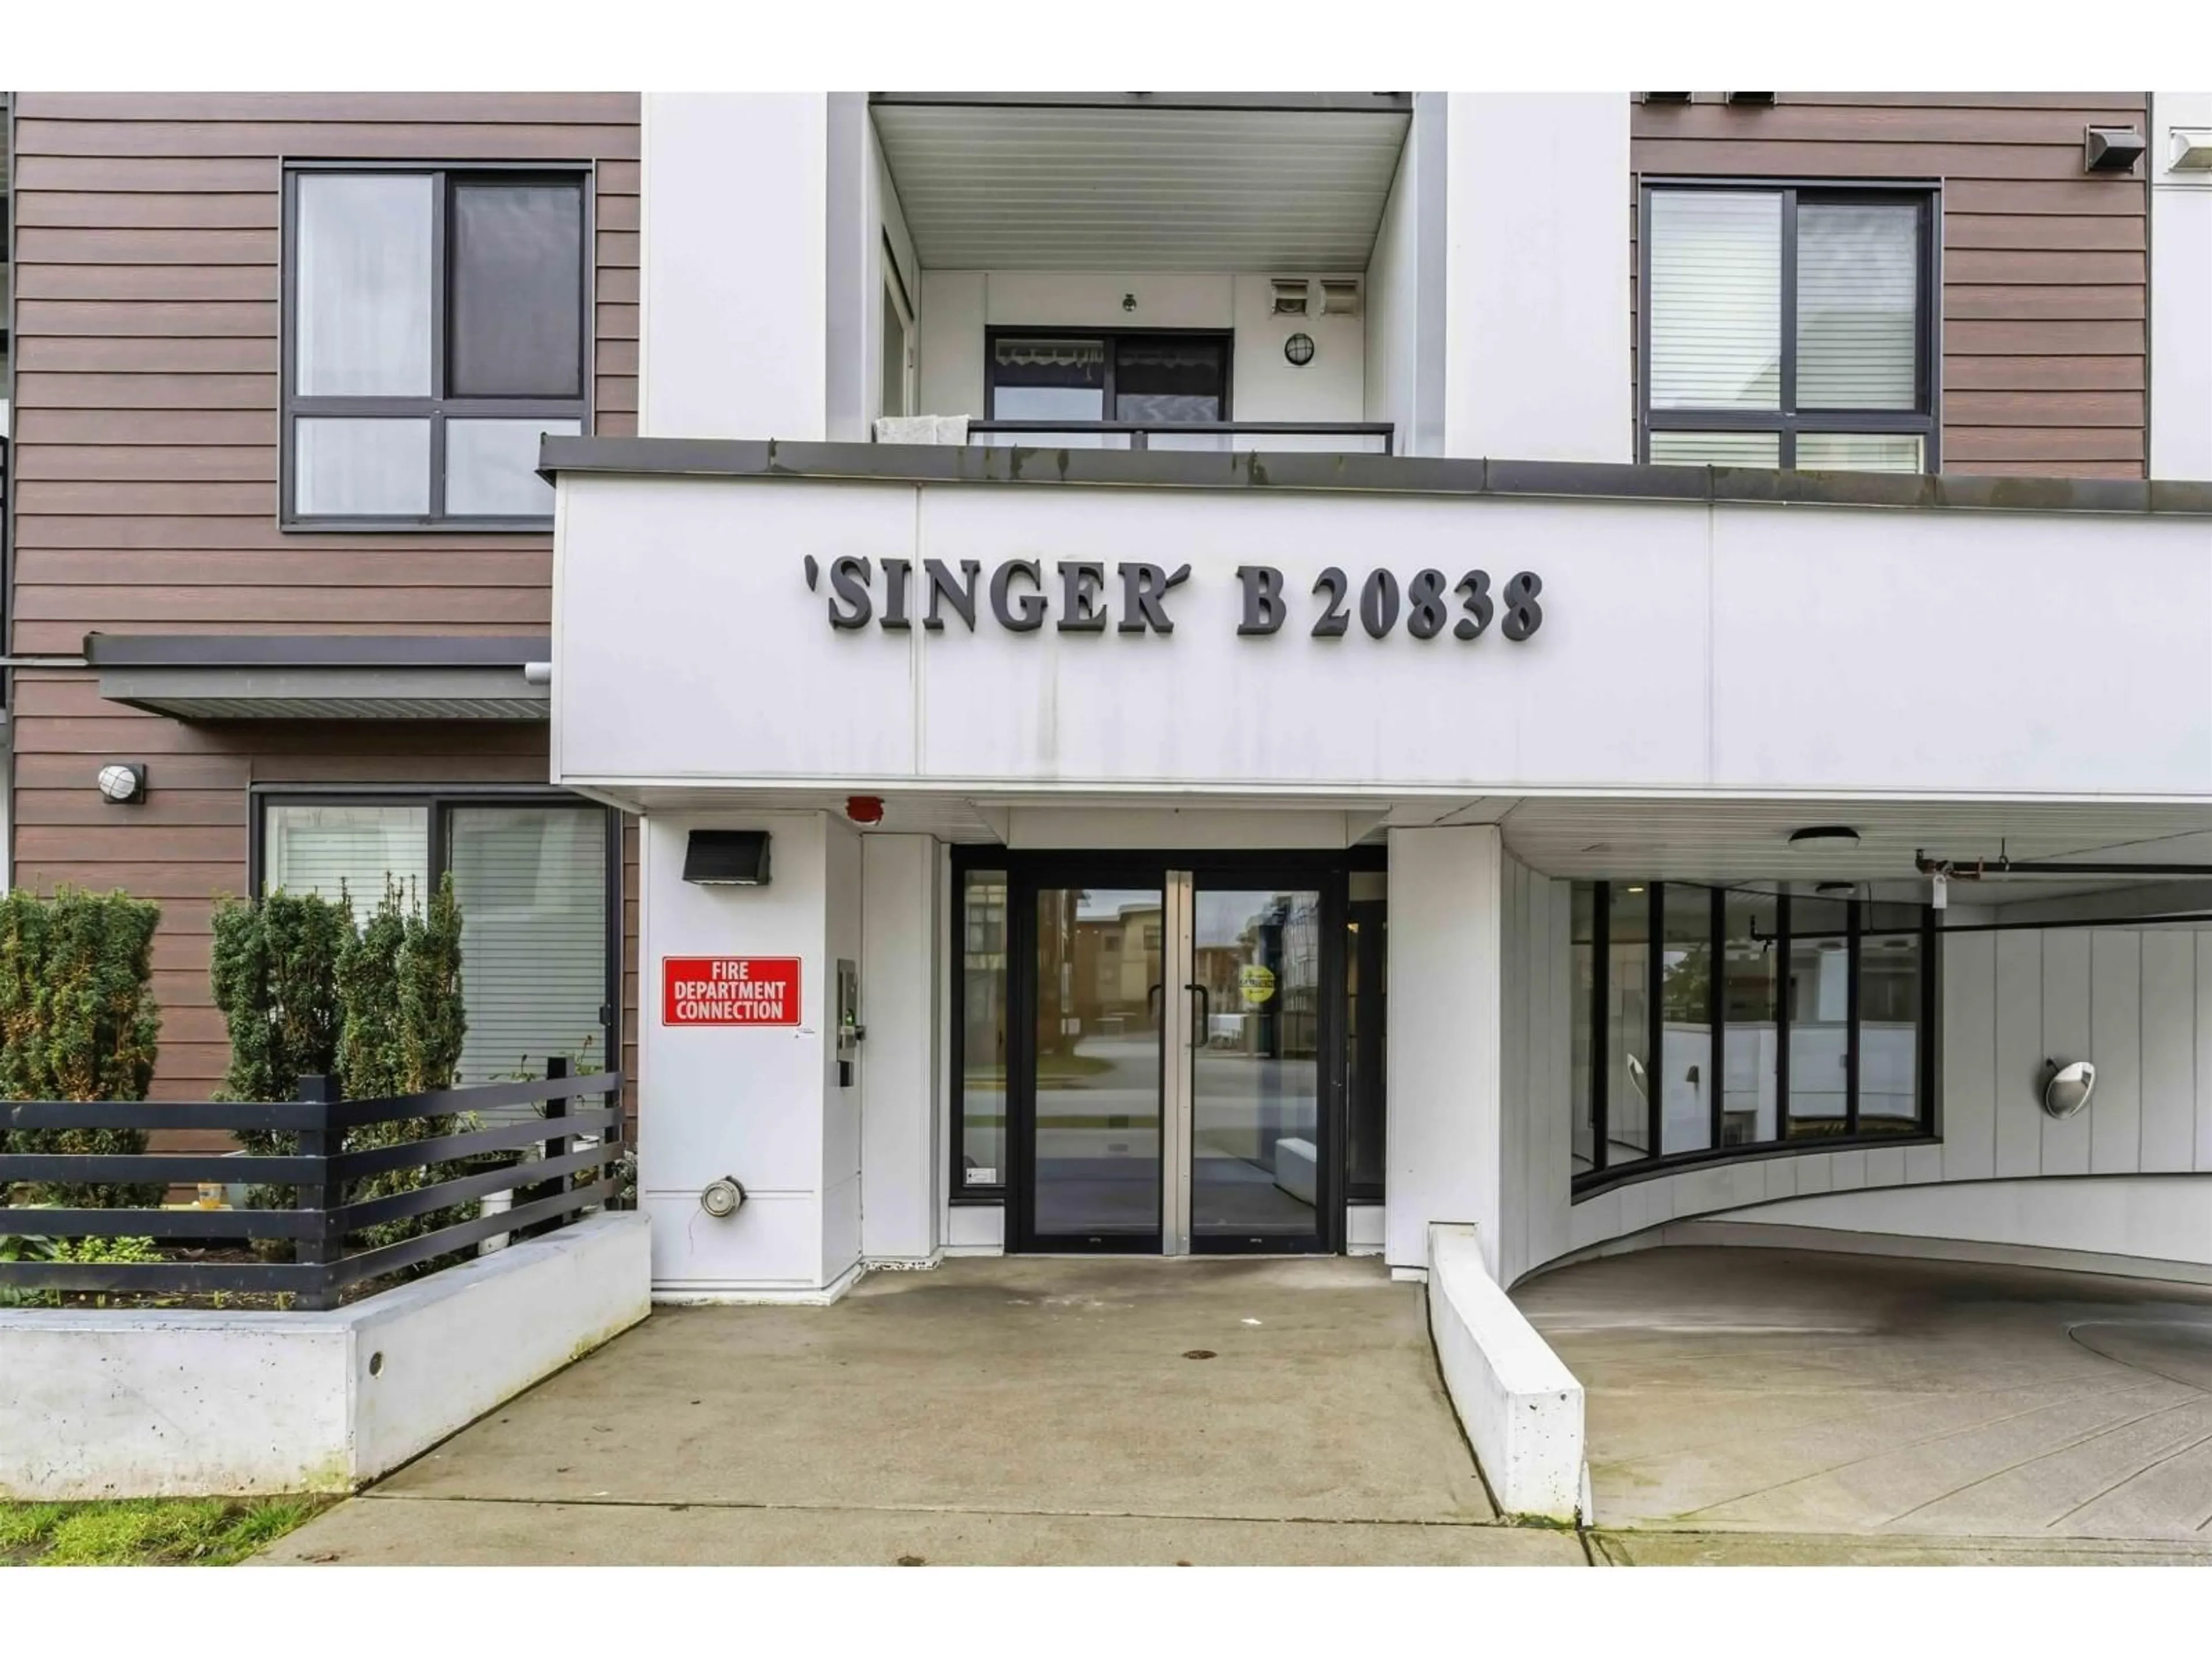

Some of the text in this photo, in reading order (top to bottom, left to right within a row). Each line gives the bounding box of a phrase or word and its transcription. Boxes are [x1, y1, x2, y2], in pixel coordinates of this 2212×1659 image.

[1236, 565, 1287, 636] B
[1311, 566, 1543, 641] 20838
[711, 961, 749, 980] FIRE
[674, 981, 786, 1000] DEPARTMENT
[675, 1001, 784, 1020] CONNECTION
